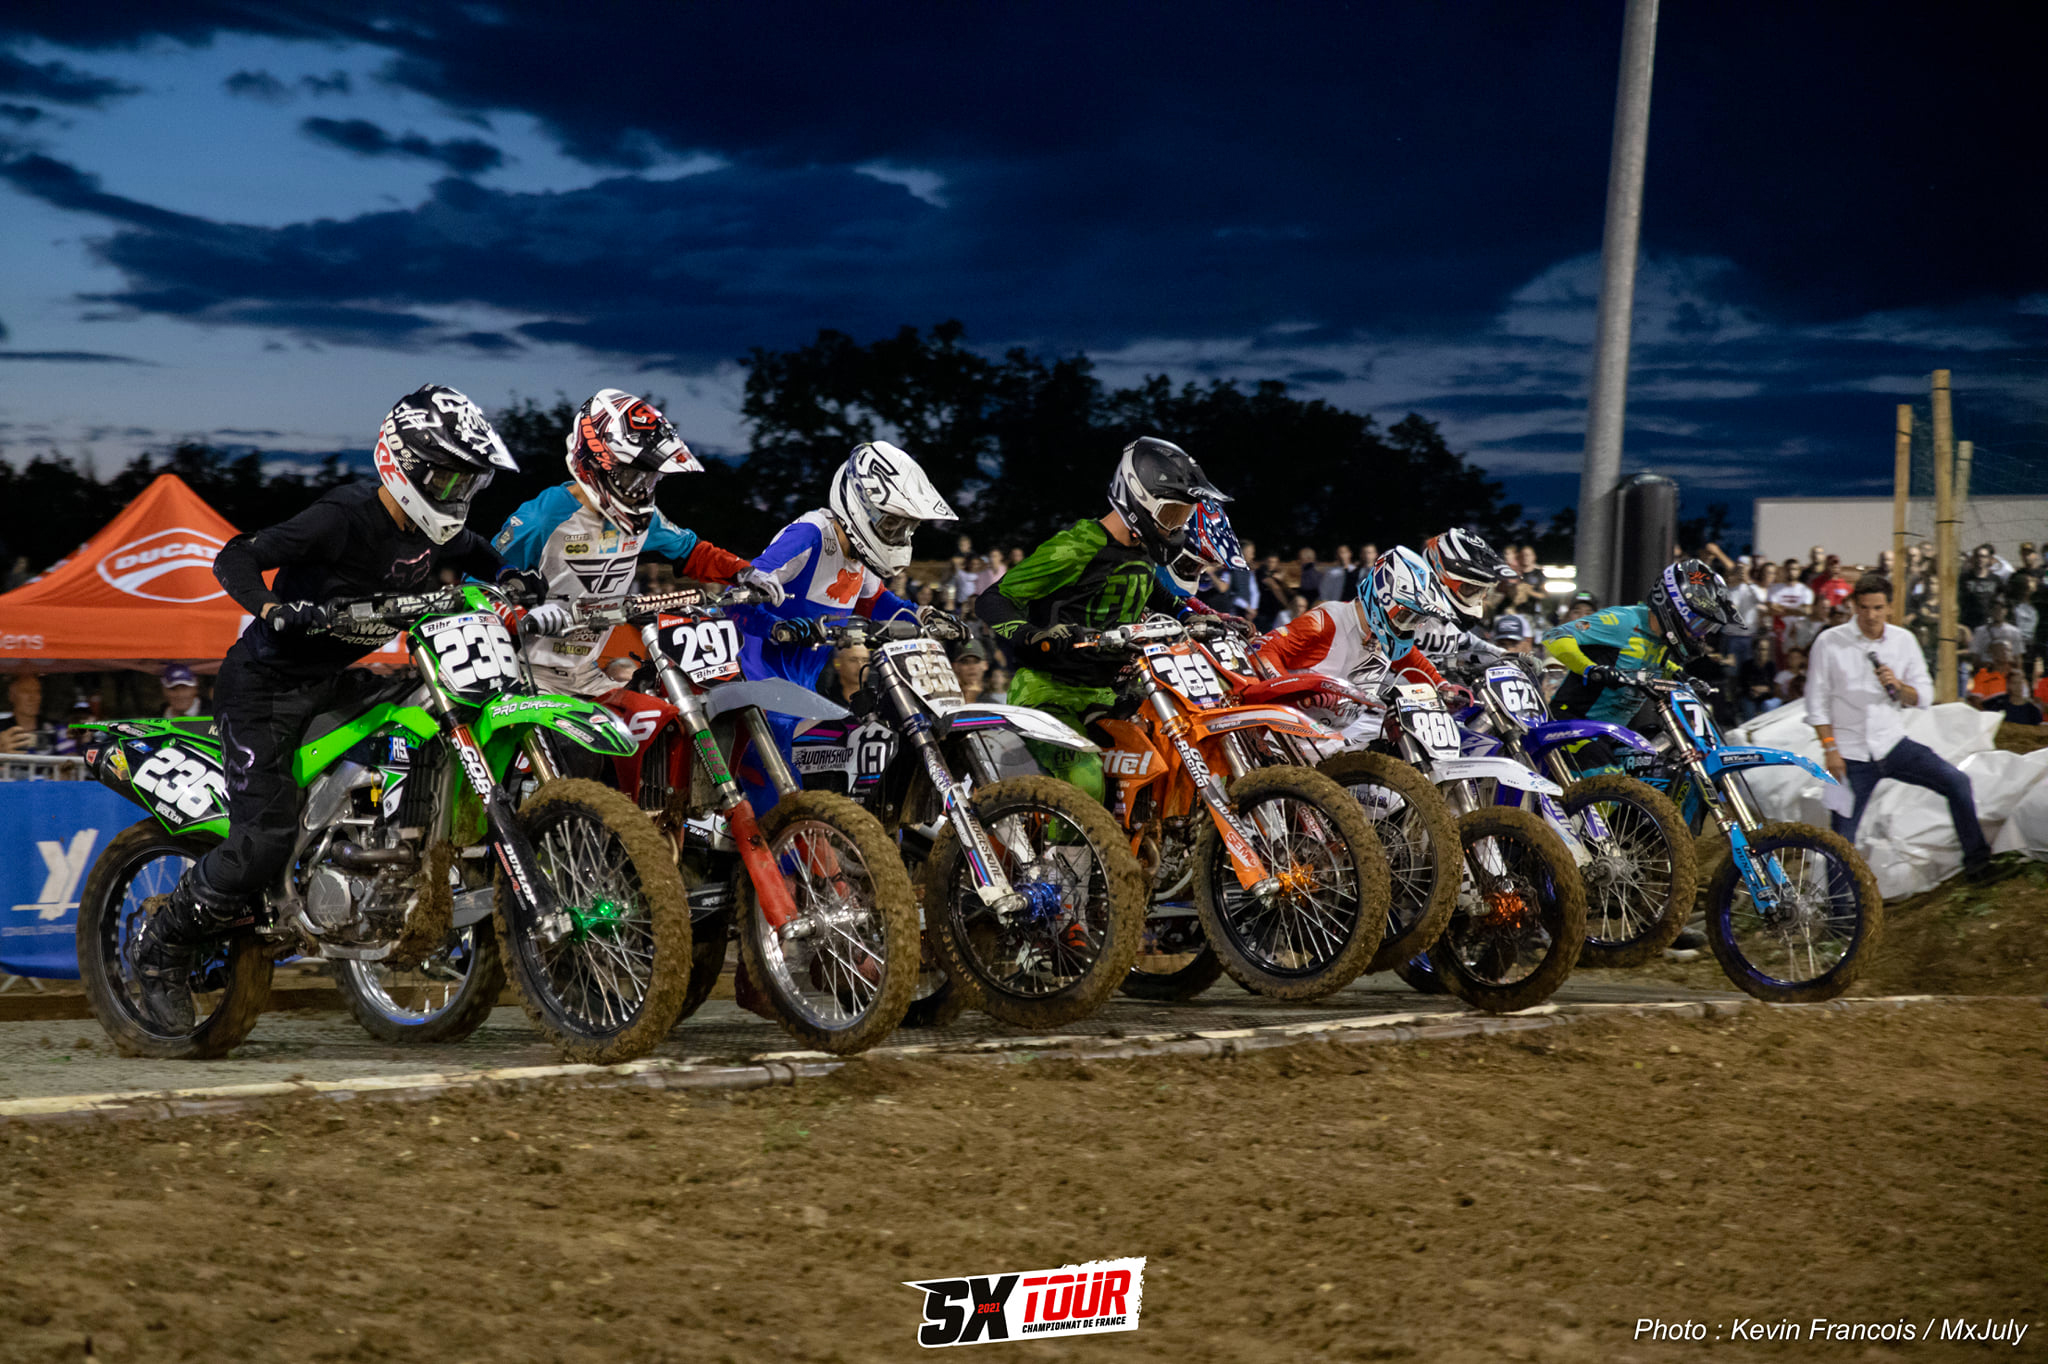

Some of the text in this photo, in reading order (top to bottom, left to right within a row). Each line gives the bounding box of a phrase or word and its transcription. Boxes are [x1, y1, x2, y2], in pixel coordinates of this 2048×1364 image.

[115, 542, 222, 570] DUCAT
[433, 624, 518, 689] 236
[672, 620, 740, 672] 297
[492, 700, 574, 719] PRO CIRCUIT
[1412, 712, 1460, 748] 860
[802, 748, 854, 765] WORKSHOP
[1177, 740, 1205, 788] Racing
[132, 747, 230, 818] 236
[503, 843, 537, 906] DUNLOP
